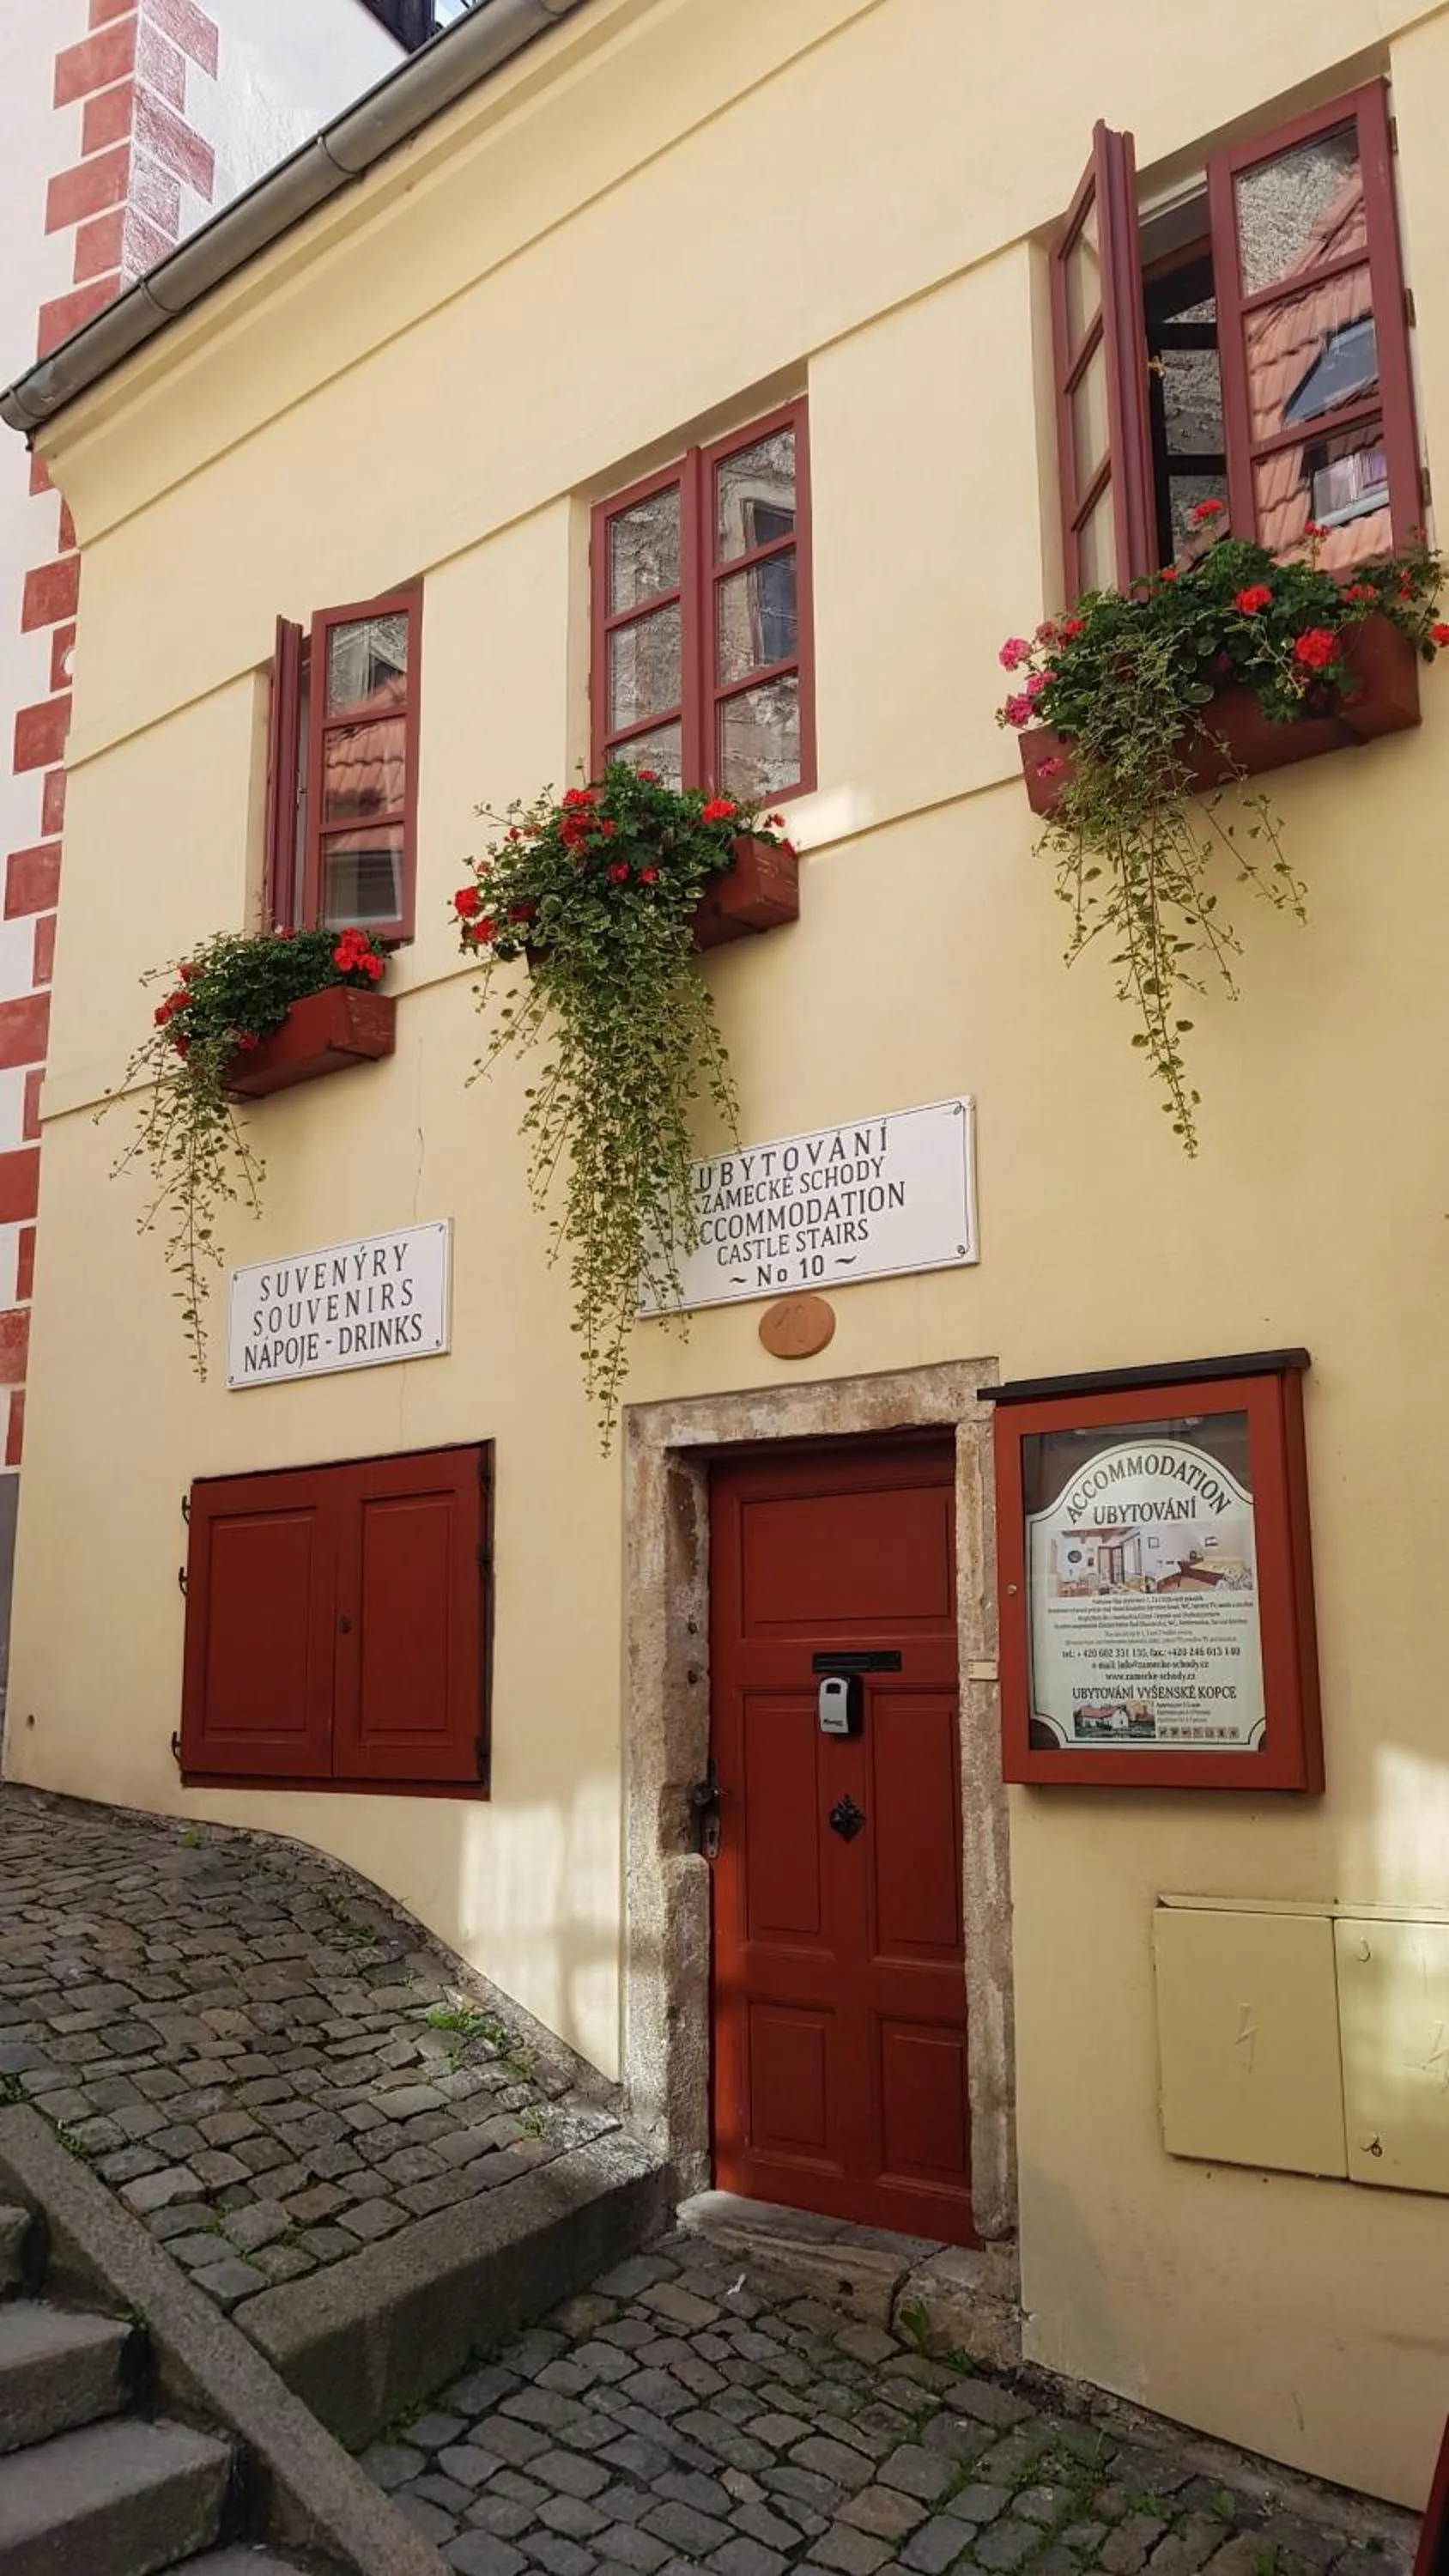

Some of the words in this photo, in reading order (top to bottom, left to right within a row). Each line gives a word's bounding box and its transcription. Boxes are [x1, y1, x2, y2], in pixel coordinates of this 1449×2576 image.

[699, 1118, 888, 1191] UBYTOVÁNÍ
[701, 1173, 794, 1215] ZÁMECKÉ
[799, 1155, 885, 1194] SCHODY
[687, 1181, 906, 1250] CCOMMODATION
[717, 1234, 790, 1267] CASTLE
[796, 1218, 869, 1253] STAIRS
[260, 1242, 409, 1302] SUVENÝRY
[757, 1263, 788, 1287] No
[799, 1255, 825, 1279] 10
[253, 1278, 414, 1336] SOUVENIRS
[244, 1332, 320, 1373] NÁPOJE
[338, 1313, 422, 1355] DRINKS
[1066, 1455, 1233, 1525] ACCOMMODATION
[1093, 1495, 1197, 1525] UBYTOVÁNÍ
[1072, 1684, 1134, 1699] UBYTOVÁNÍ
[1137, 1684, 1197, 1699] VYŠENSKÉ
[1197, 1685, 1237, 1699] KOPCE
